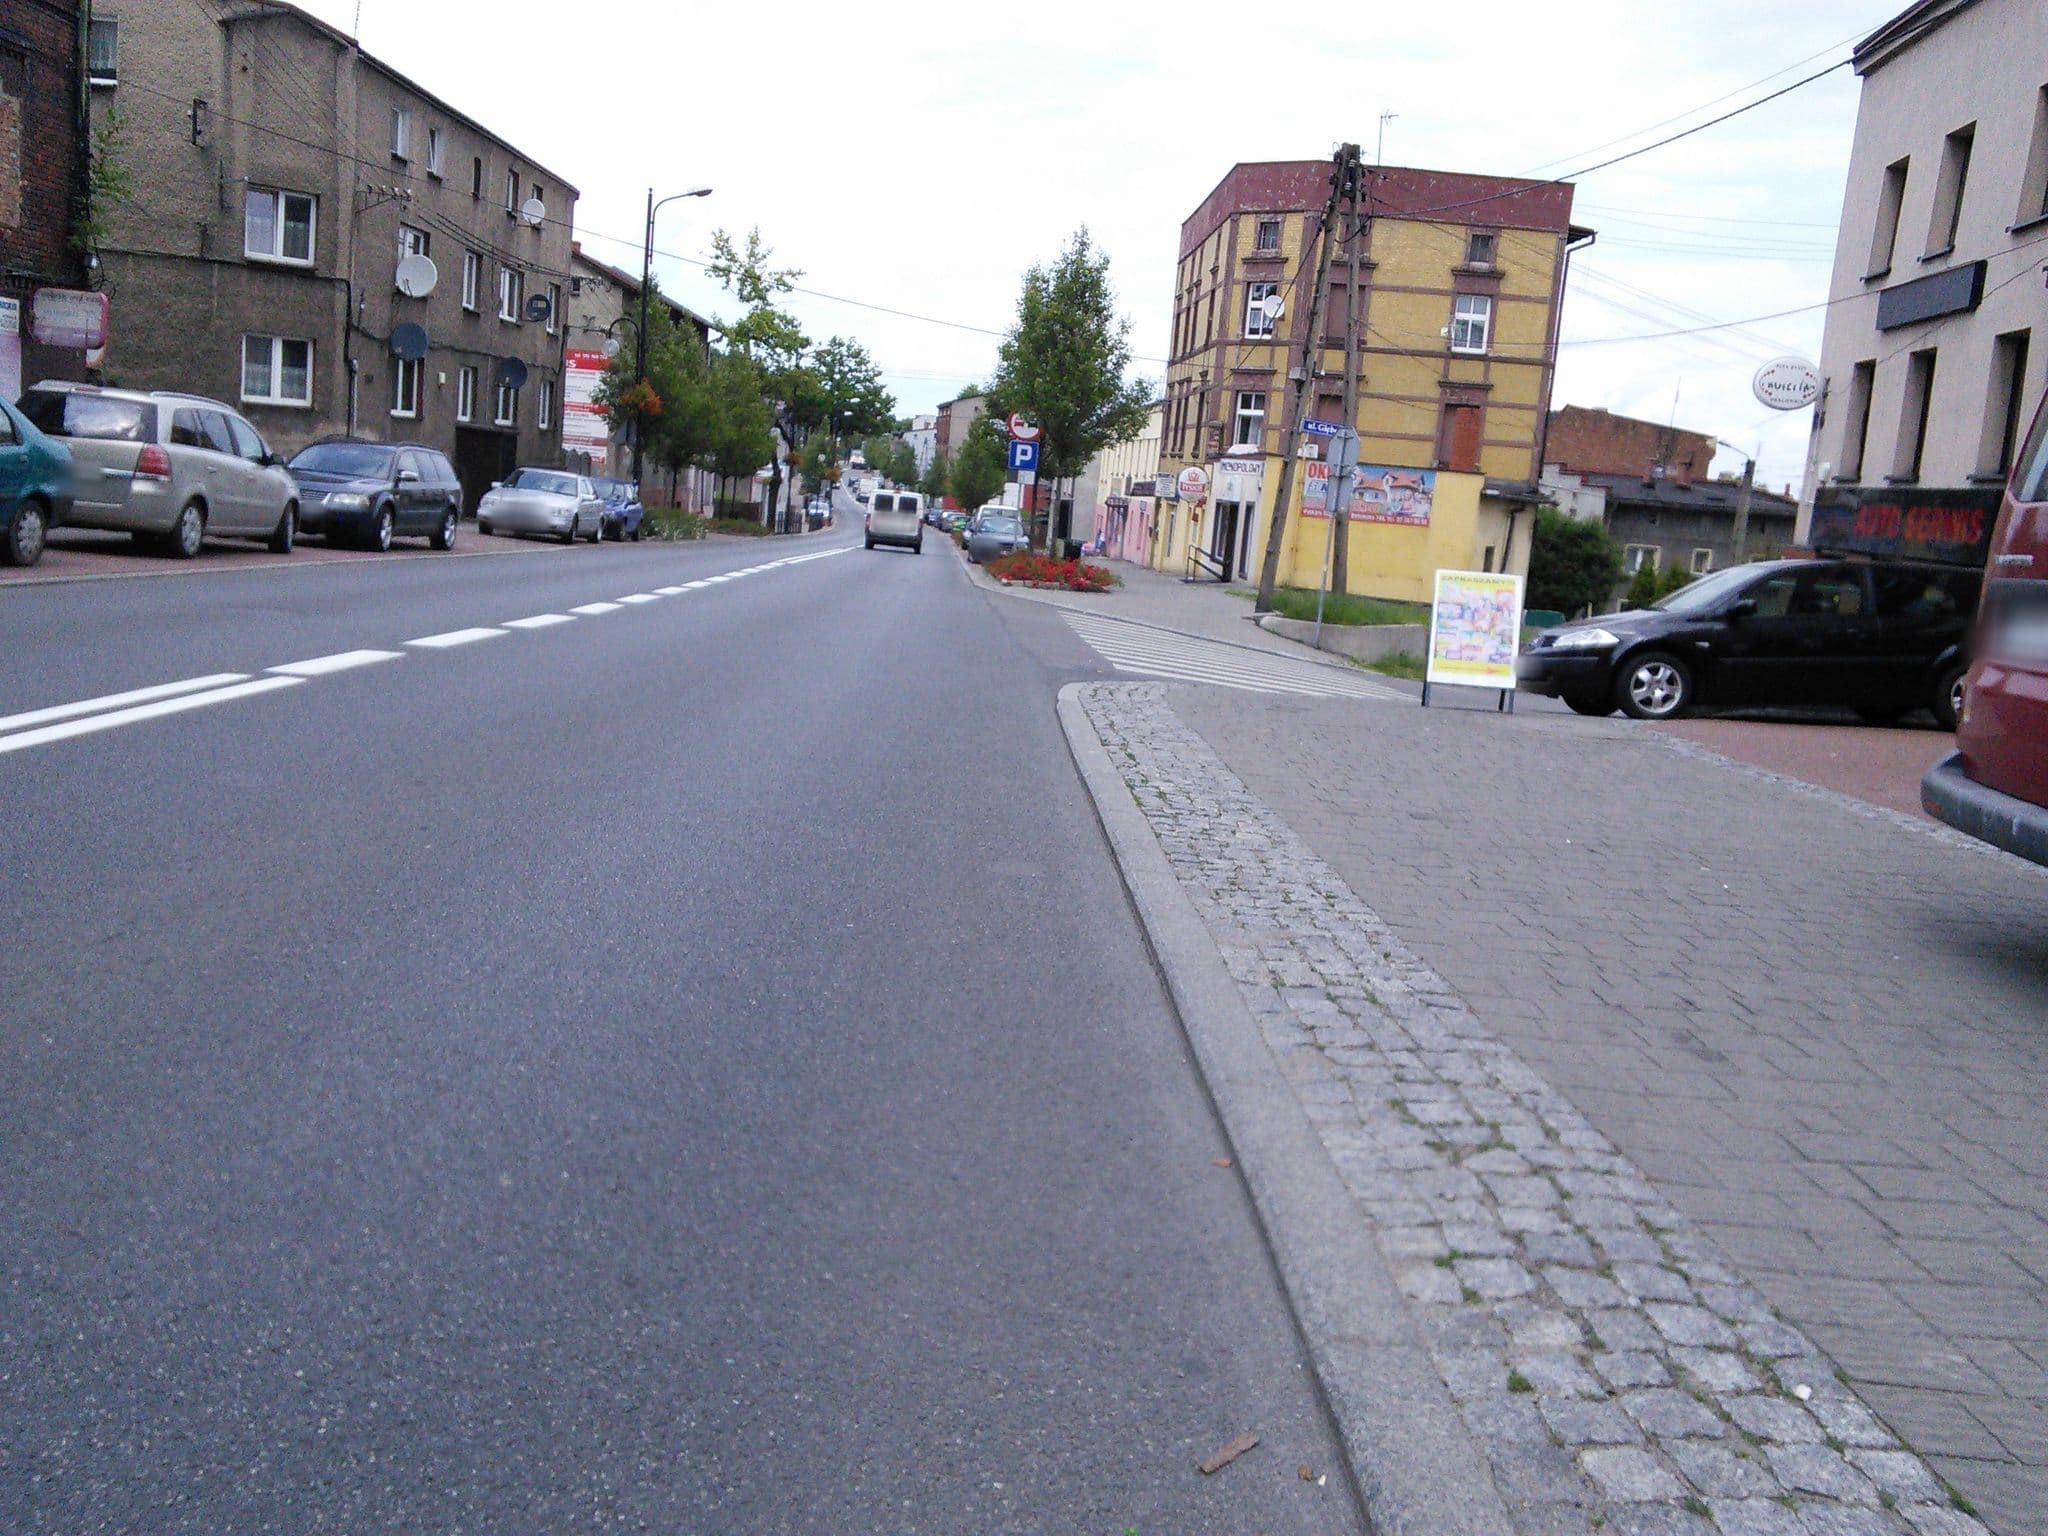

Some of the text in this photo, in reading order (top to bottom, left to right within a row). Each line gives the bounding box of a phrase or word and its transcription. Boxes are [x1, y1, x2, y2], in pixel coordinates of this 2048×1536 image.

[1318, 422, 1338, 435] Głęb
[1015, 444, 1033, 466] P
[1222, 462, 1261, 473] MONOPOLOWY
[1308, 463, 1331, 479] OK
[1855, 504, 1984, 545] AUTO SERWIS
